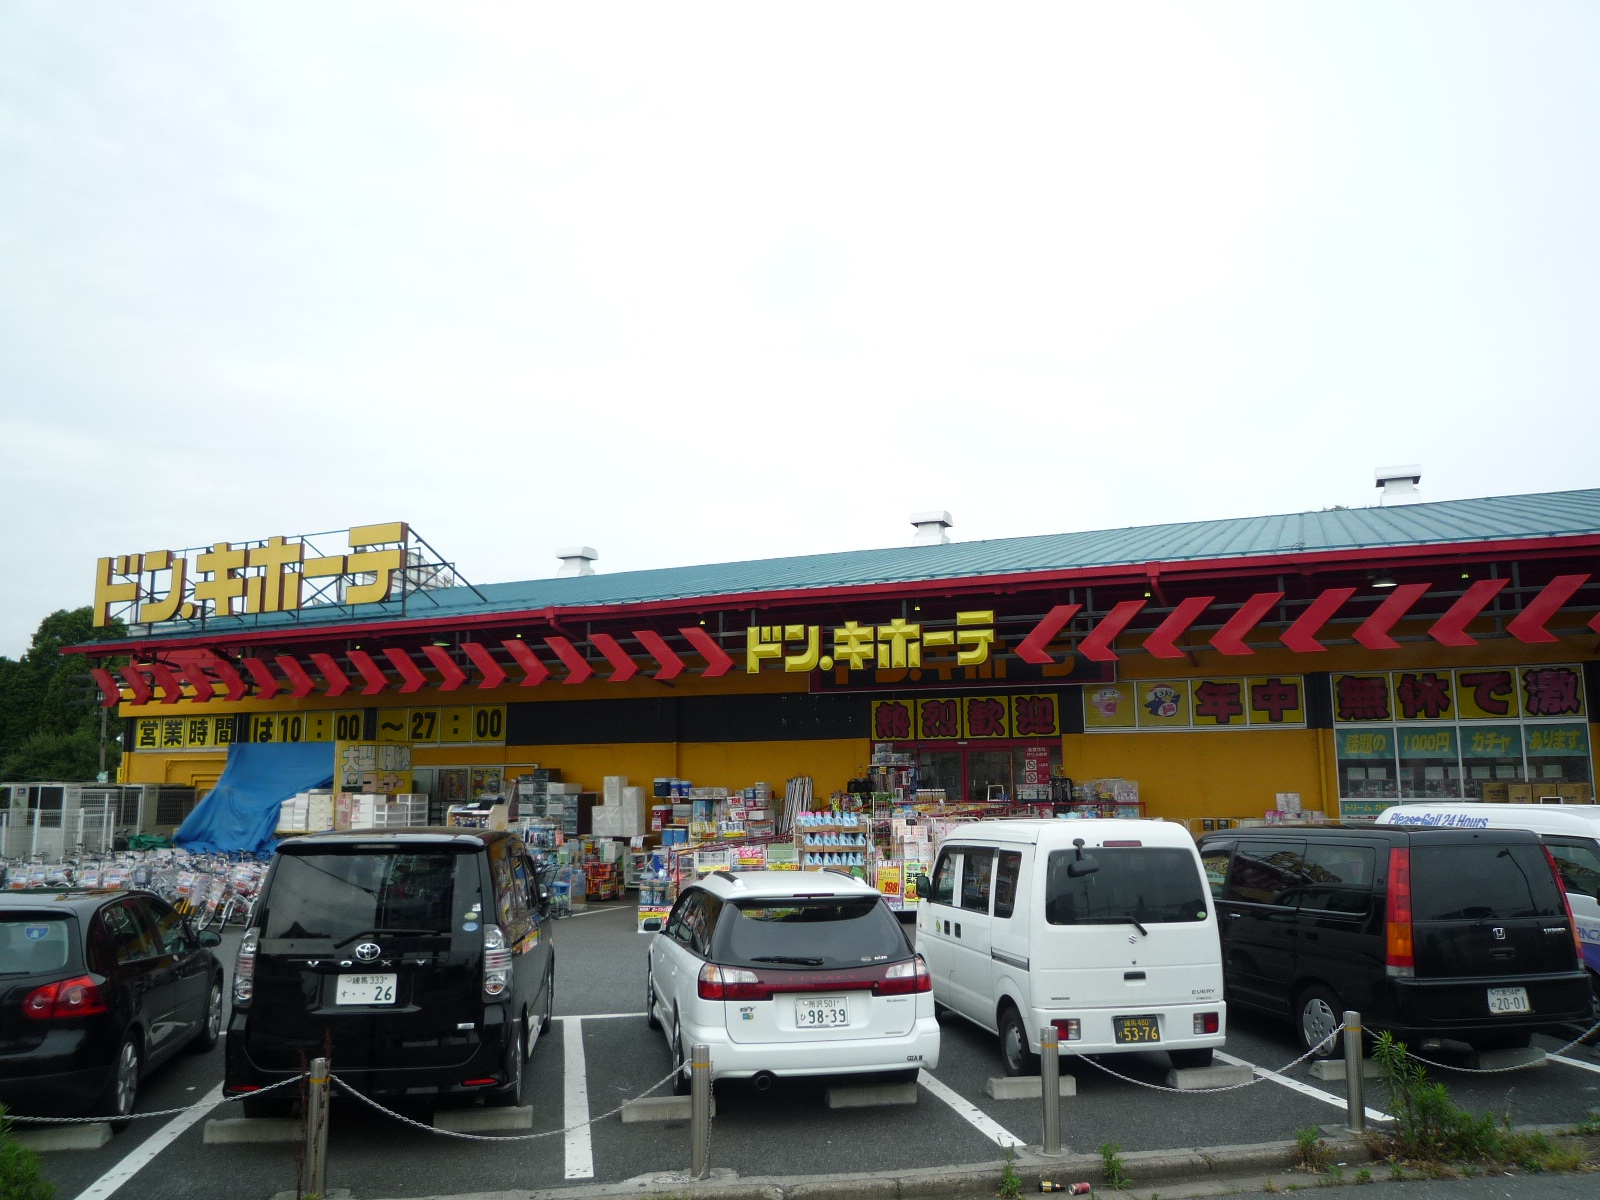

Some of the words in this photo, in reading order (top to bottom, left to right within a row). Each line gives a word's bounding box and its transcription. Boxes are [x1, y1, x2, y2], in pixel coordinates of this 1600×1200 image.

[1441, 814, 1457, 827] 24
[1456, 815, 1489, 828] Hours
[884, 882, 899, 893] 198
[824, 999, 837, 1008] 501
[1496, 996, 1527, 1011] 20-01
[808, 1008, 846, 1024] 98-39
[1123, 1026, 1158, 1041] 53-76
